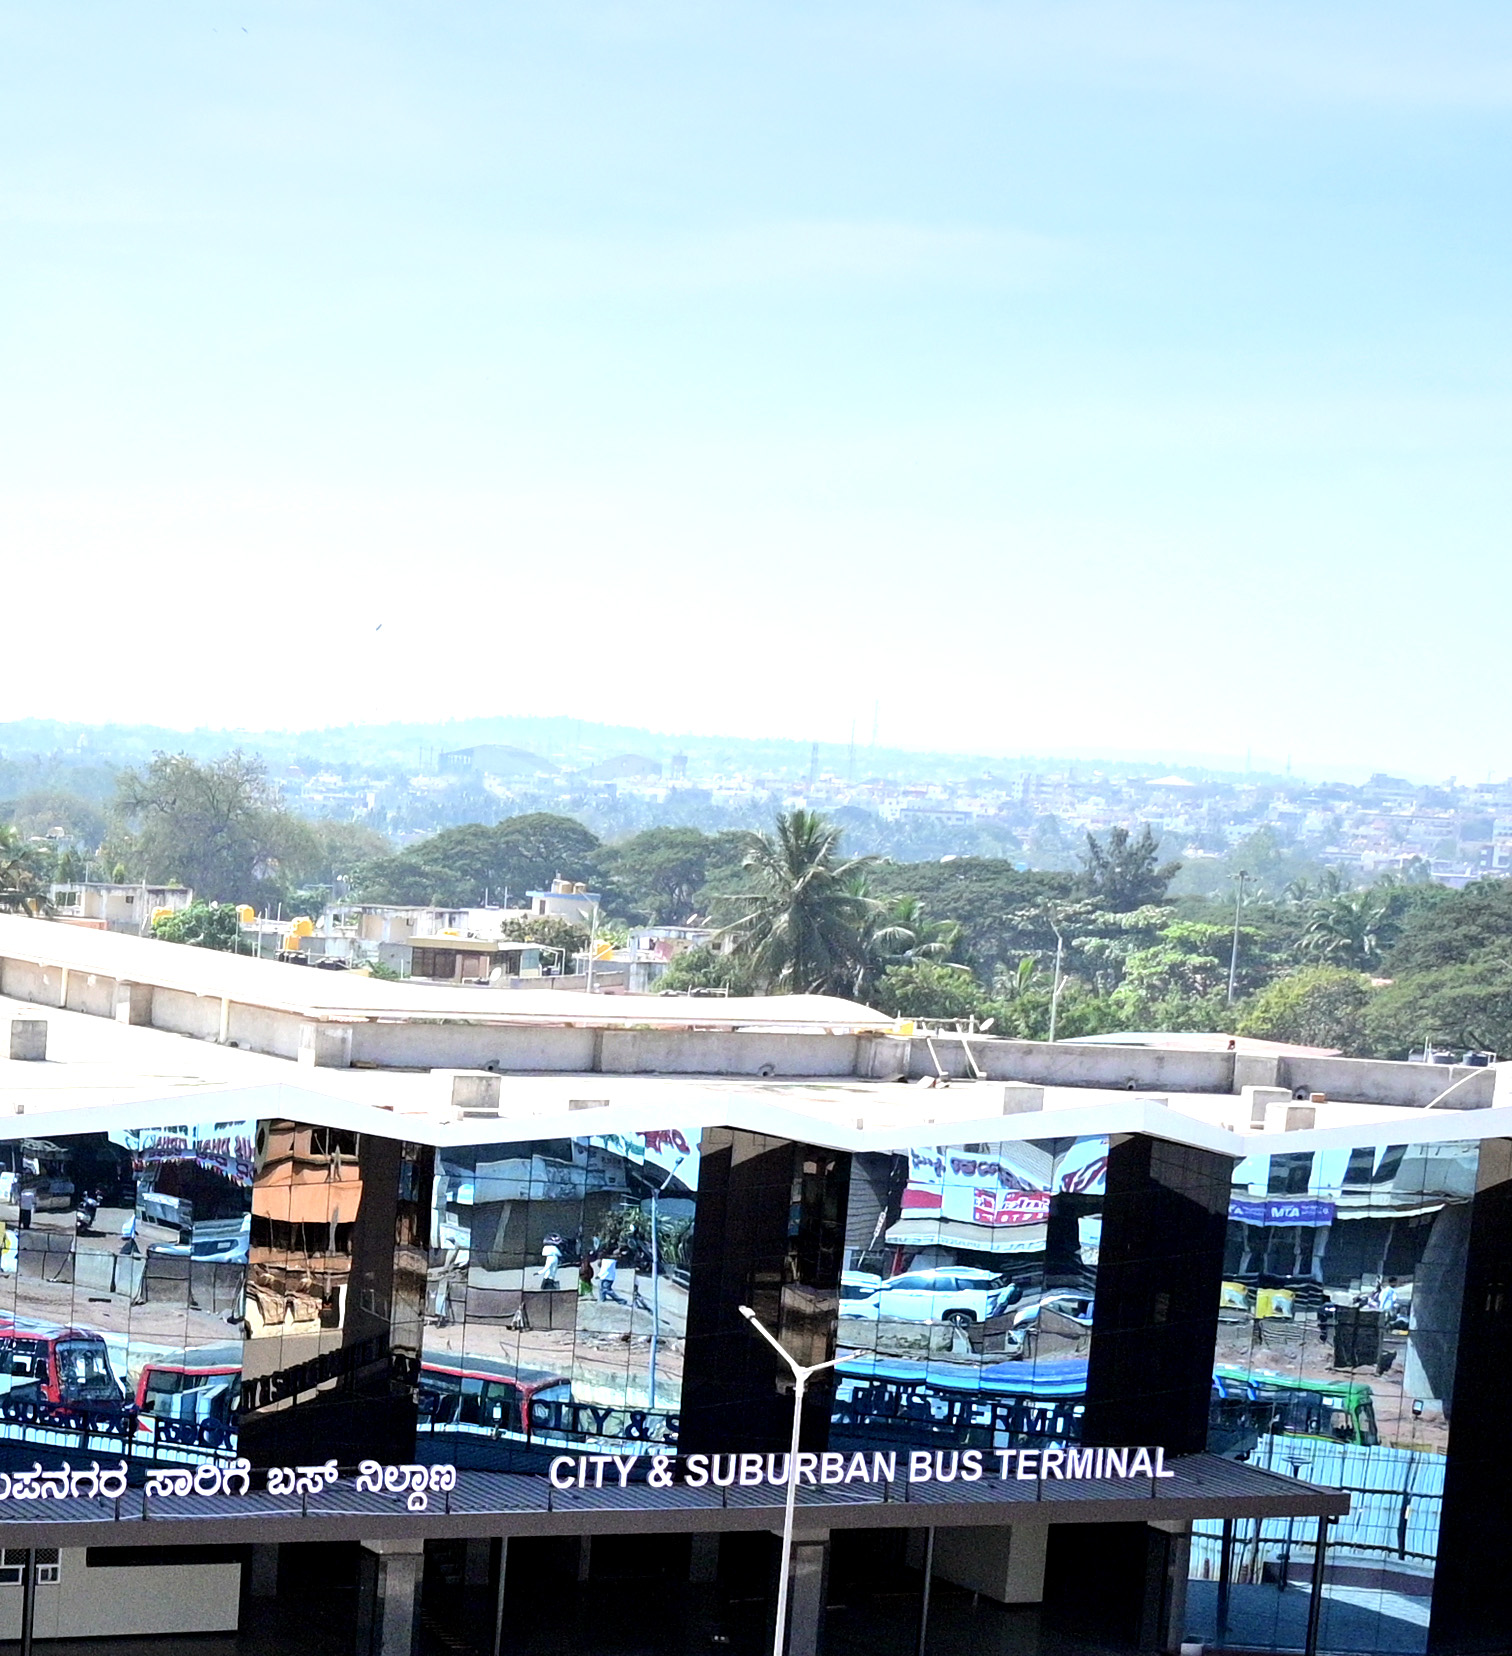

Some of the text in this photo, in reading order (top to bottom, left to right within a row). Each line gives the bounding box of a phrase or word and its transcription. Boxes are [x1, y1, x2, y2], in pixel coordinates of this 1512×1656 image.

[144, 1458, 252, 1500] ಸಾರಿಗೆ
[267, 1455, 338, 1498] ಬಸ್
[356, 1459, 458, 1514] ನಿಲ್ದಾಣ
[549, 1446, 1176, 1489] CITY & SUBURBAN BUS TERMINAL
